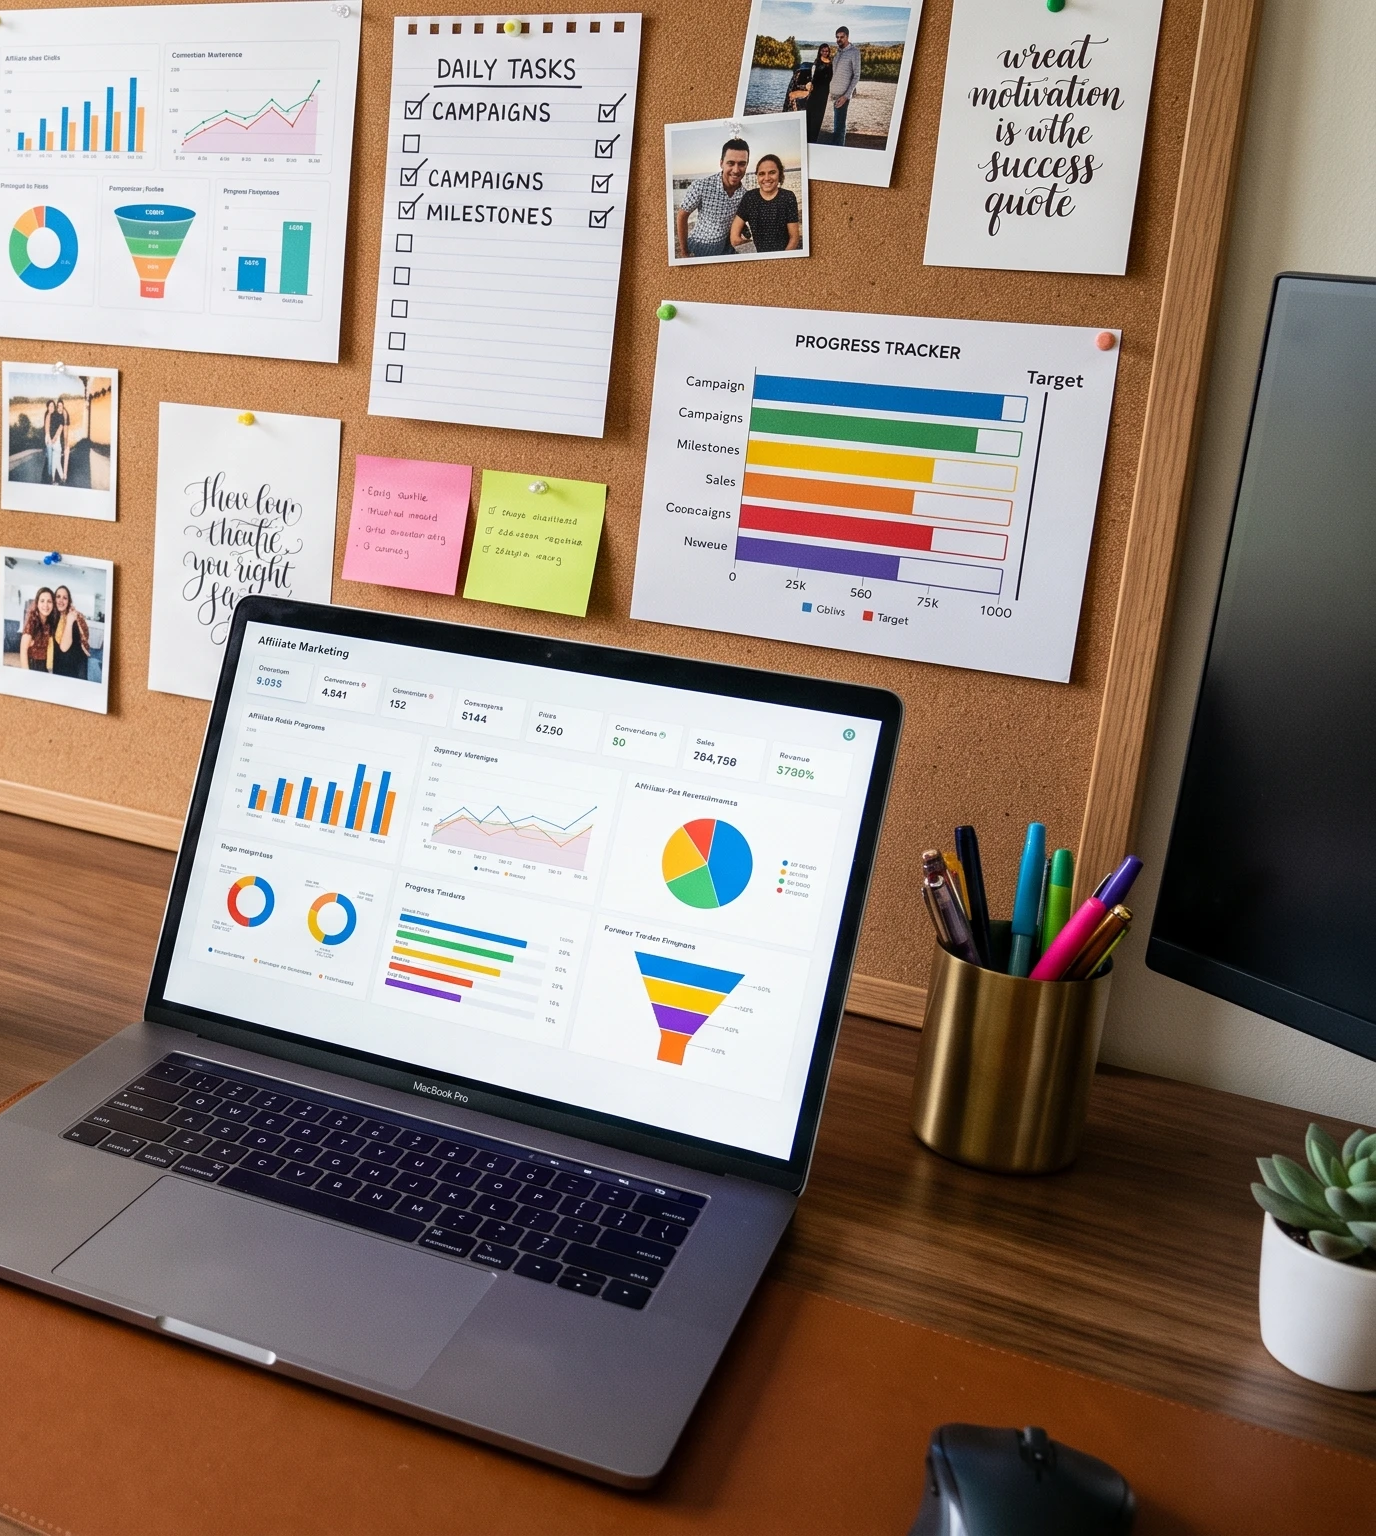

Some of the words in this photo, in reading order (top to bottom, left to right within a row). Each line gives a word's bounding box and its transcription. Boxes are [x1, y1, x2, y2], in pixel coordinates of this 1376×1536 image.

[437, 58, 498, 81] DAILY
[507, 57, 576, 81] TASKS
[967, 74, 1125, 111] motivation
[432, 101, 551, 122] CAMPAIGNS
[996, 117, 1022, 146] is
[977, 151, 1104, 185] success
[428, 169, 543, 191] CAMPAIGNS
[426, 204, 553, 227] MILESTONES
[985, 182, 1076, 237] quote
[795, 334, 881, 354] PROGRESS
[884, 341, 962, 360] TRACKER
[685, 375, 745, 393] Campaign
[1026, 370, 1084, 391] Target
[678, 407, 744, 424] Campaigns
[676, 439, 740, 455] Milestones
[705, 474, 736, 487] Sales
[728, 571, 737, 582] 0
[849, 588, 872, 600] 560
[980, 605, 1012, 619] 1000
[877, 612, 909, 626] Target
[298, 641, 350, 660] Marketing
[389, 699, 407, 710] 152
[696, 738, 716, 748] Sales
[404, 882, 435, 895] Progress
[413, 1081, 453, 1099] MacBook
[453, 1091, 469, 1103] Pro
